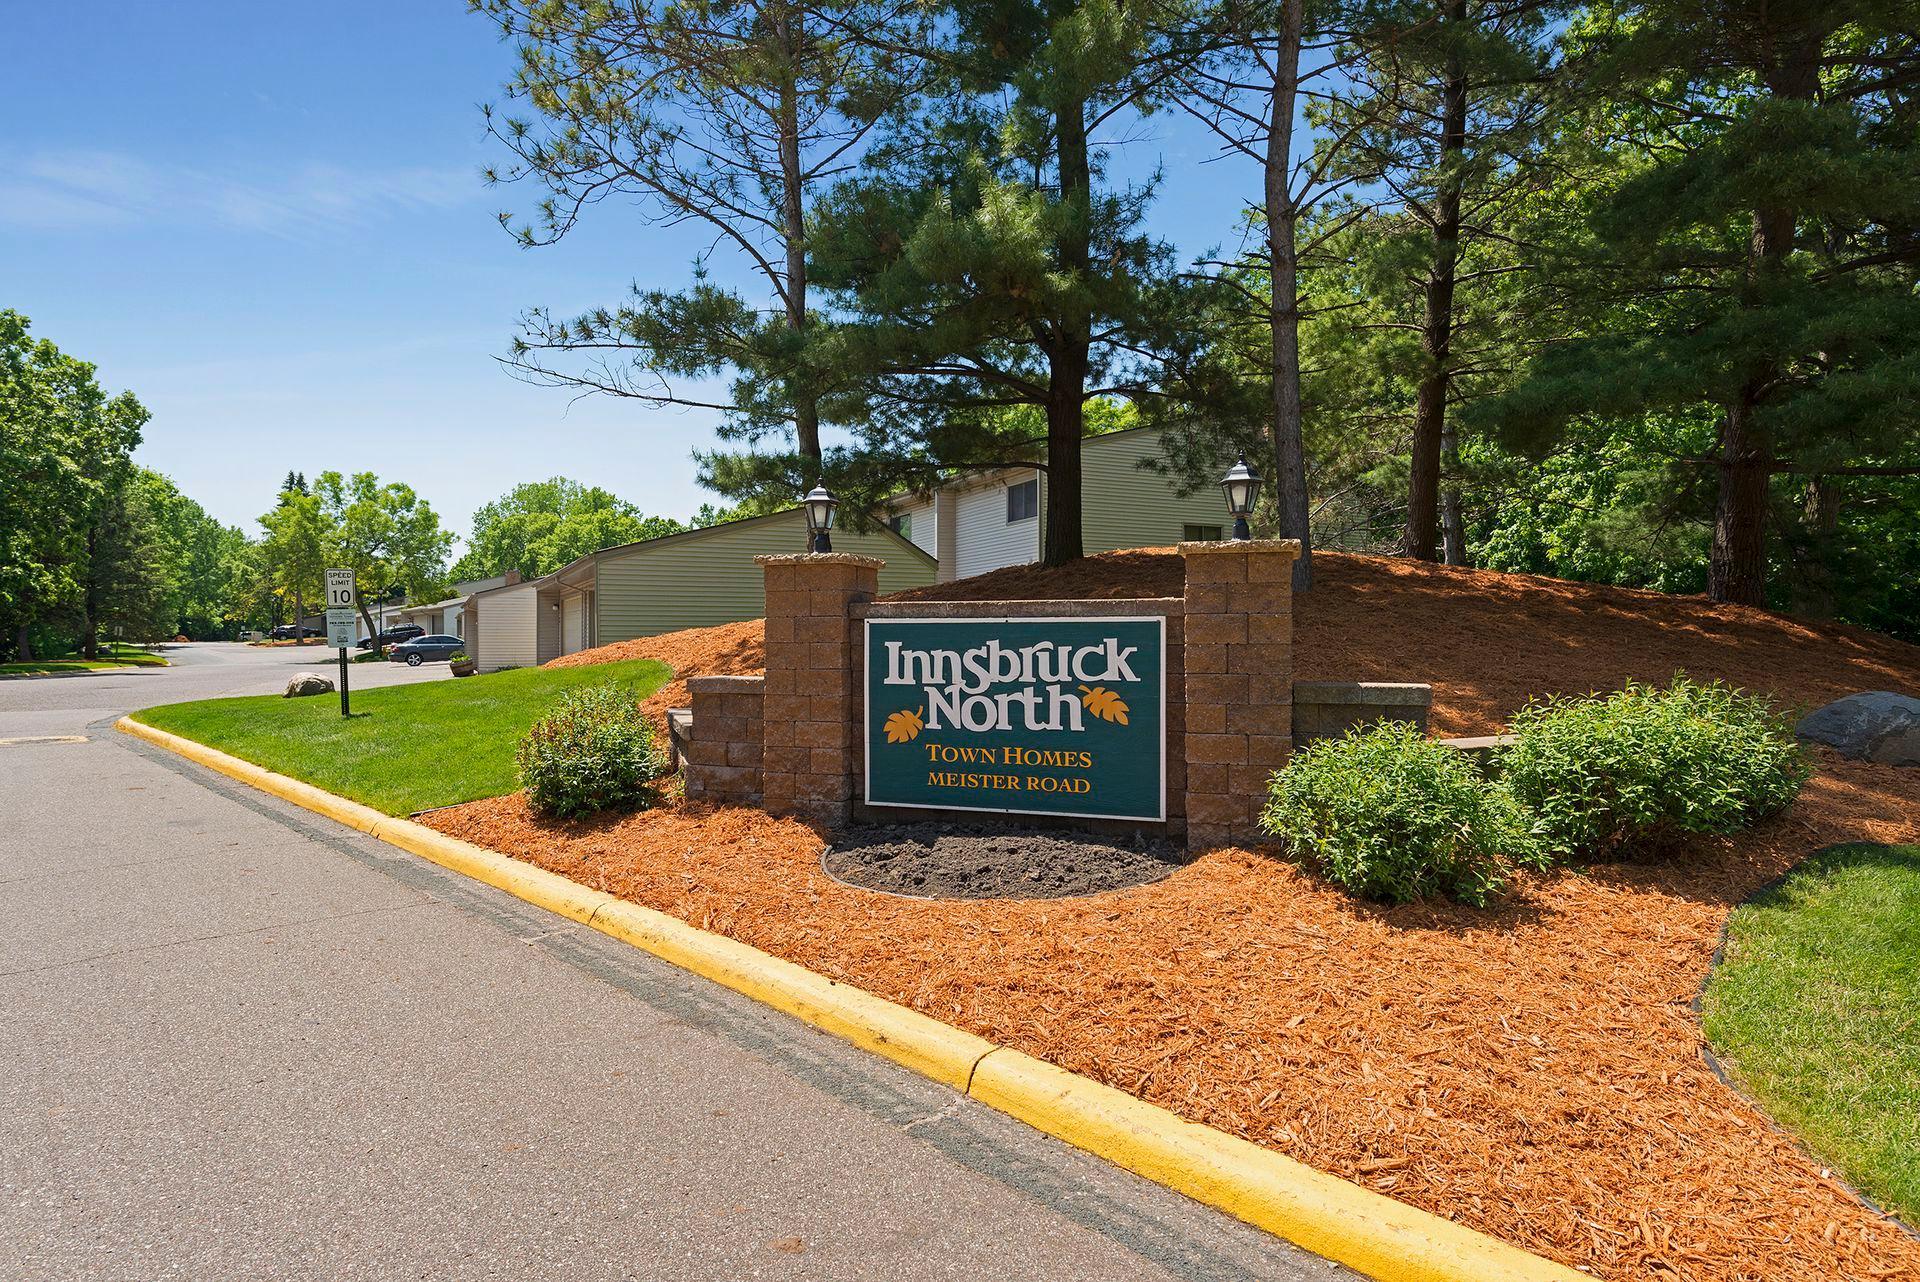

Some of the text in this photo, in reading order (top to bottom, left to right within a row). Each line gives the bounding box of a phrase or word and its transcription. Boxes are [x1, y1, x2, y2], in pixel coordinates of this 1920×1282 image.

[332, 590, 351, 603] 10
[883, 638, 1141, 694] Innsbruck
[923, 684, 1085, 732] North
[925, 744, 1092, 768] TOWN HOMES
[927, 772, 1091, 794] MEISTER ROAD
